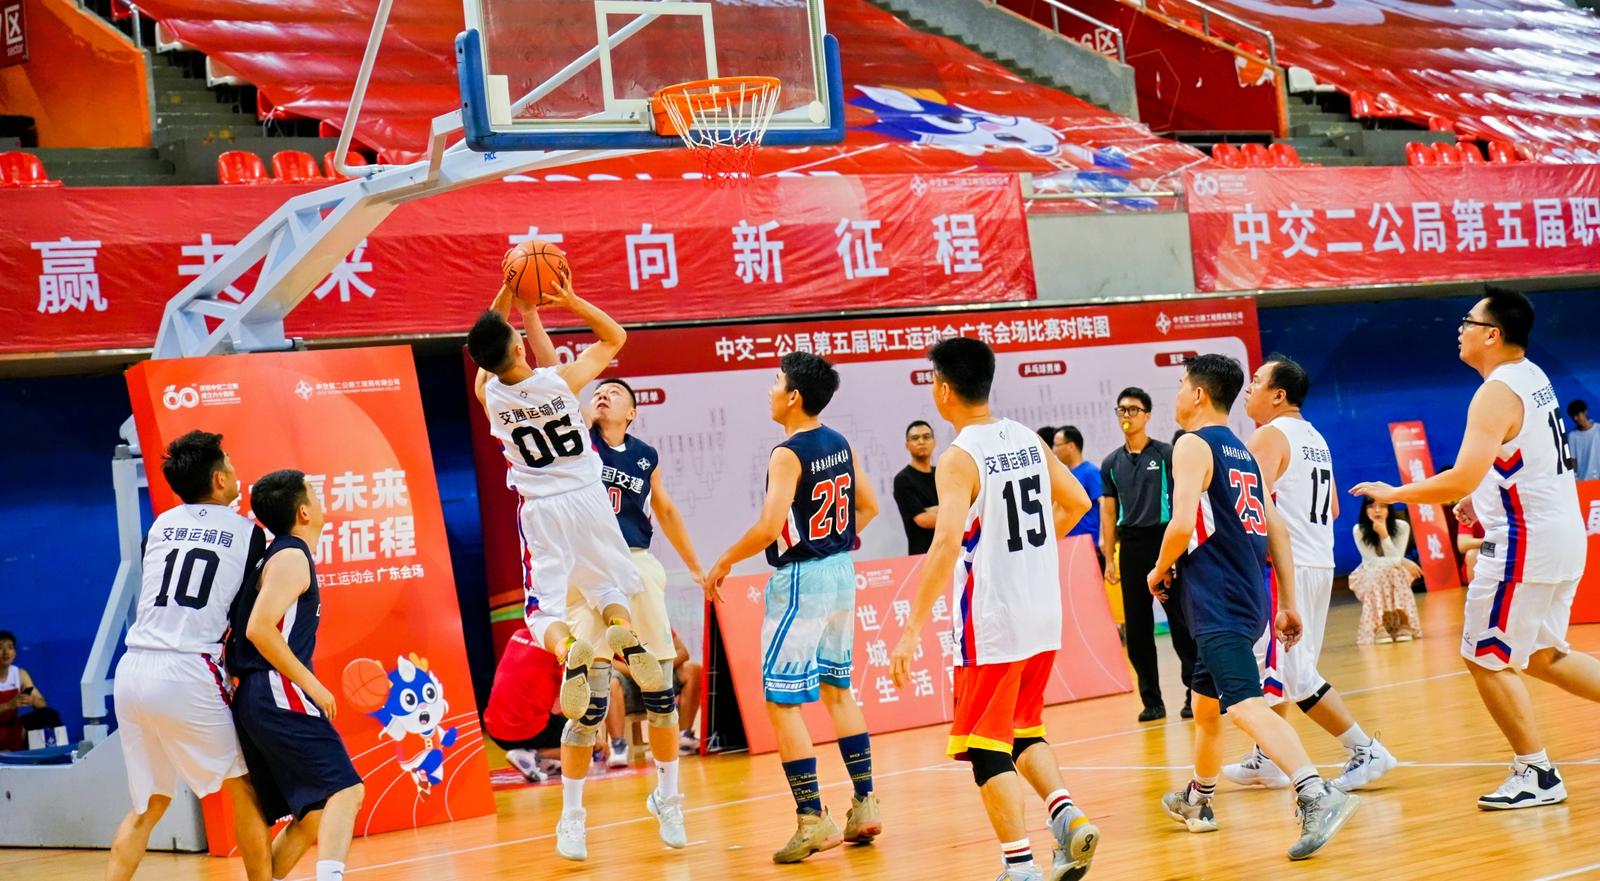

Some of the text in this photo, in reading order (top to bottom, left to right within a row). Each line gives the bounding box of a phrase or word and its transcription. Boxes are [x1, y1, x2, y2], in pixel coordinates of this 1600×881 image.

[498, 396, 565, 426] 交通运输局
[511, 413, 585, 469] 06
[984, 445, 1042, 476] 交通运输局
[808, 472, 852, 541] 26
[1002, 474, 1047, 553] 15
[1228, 467, 1268, 537] 25
[1309, 466, 1332, 526] 17
[162, 527, 235, 549] 交通运输局
[153, 547, 222, 611] 10
